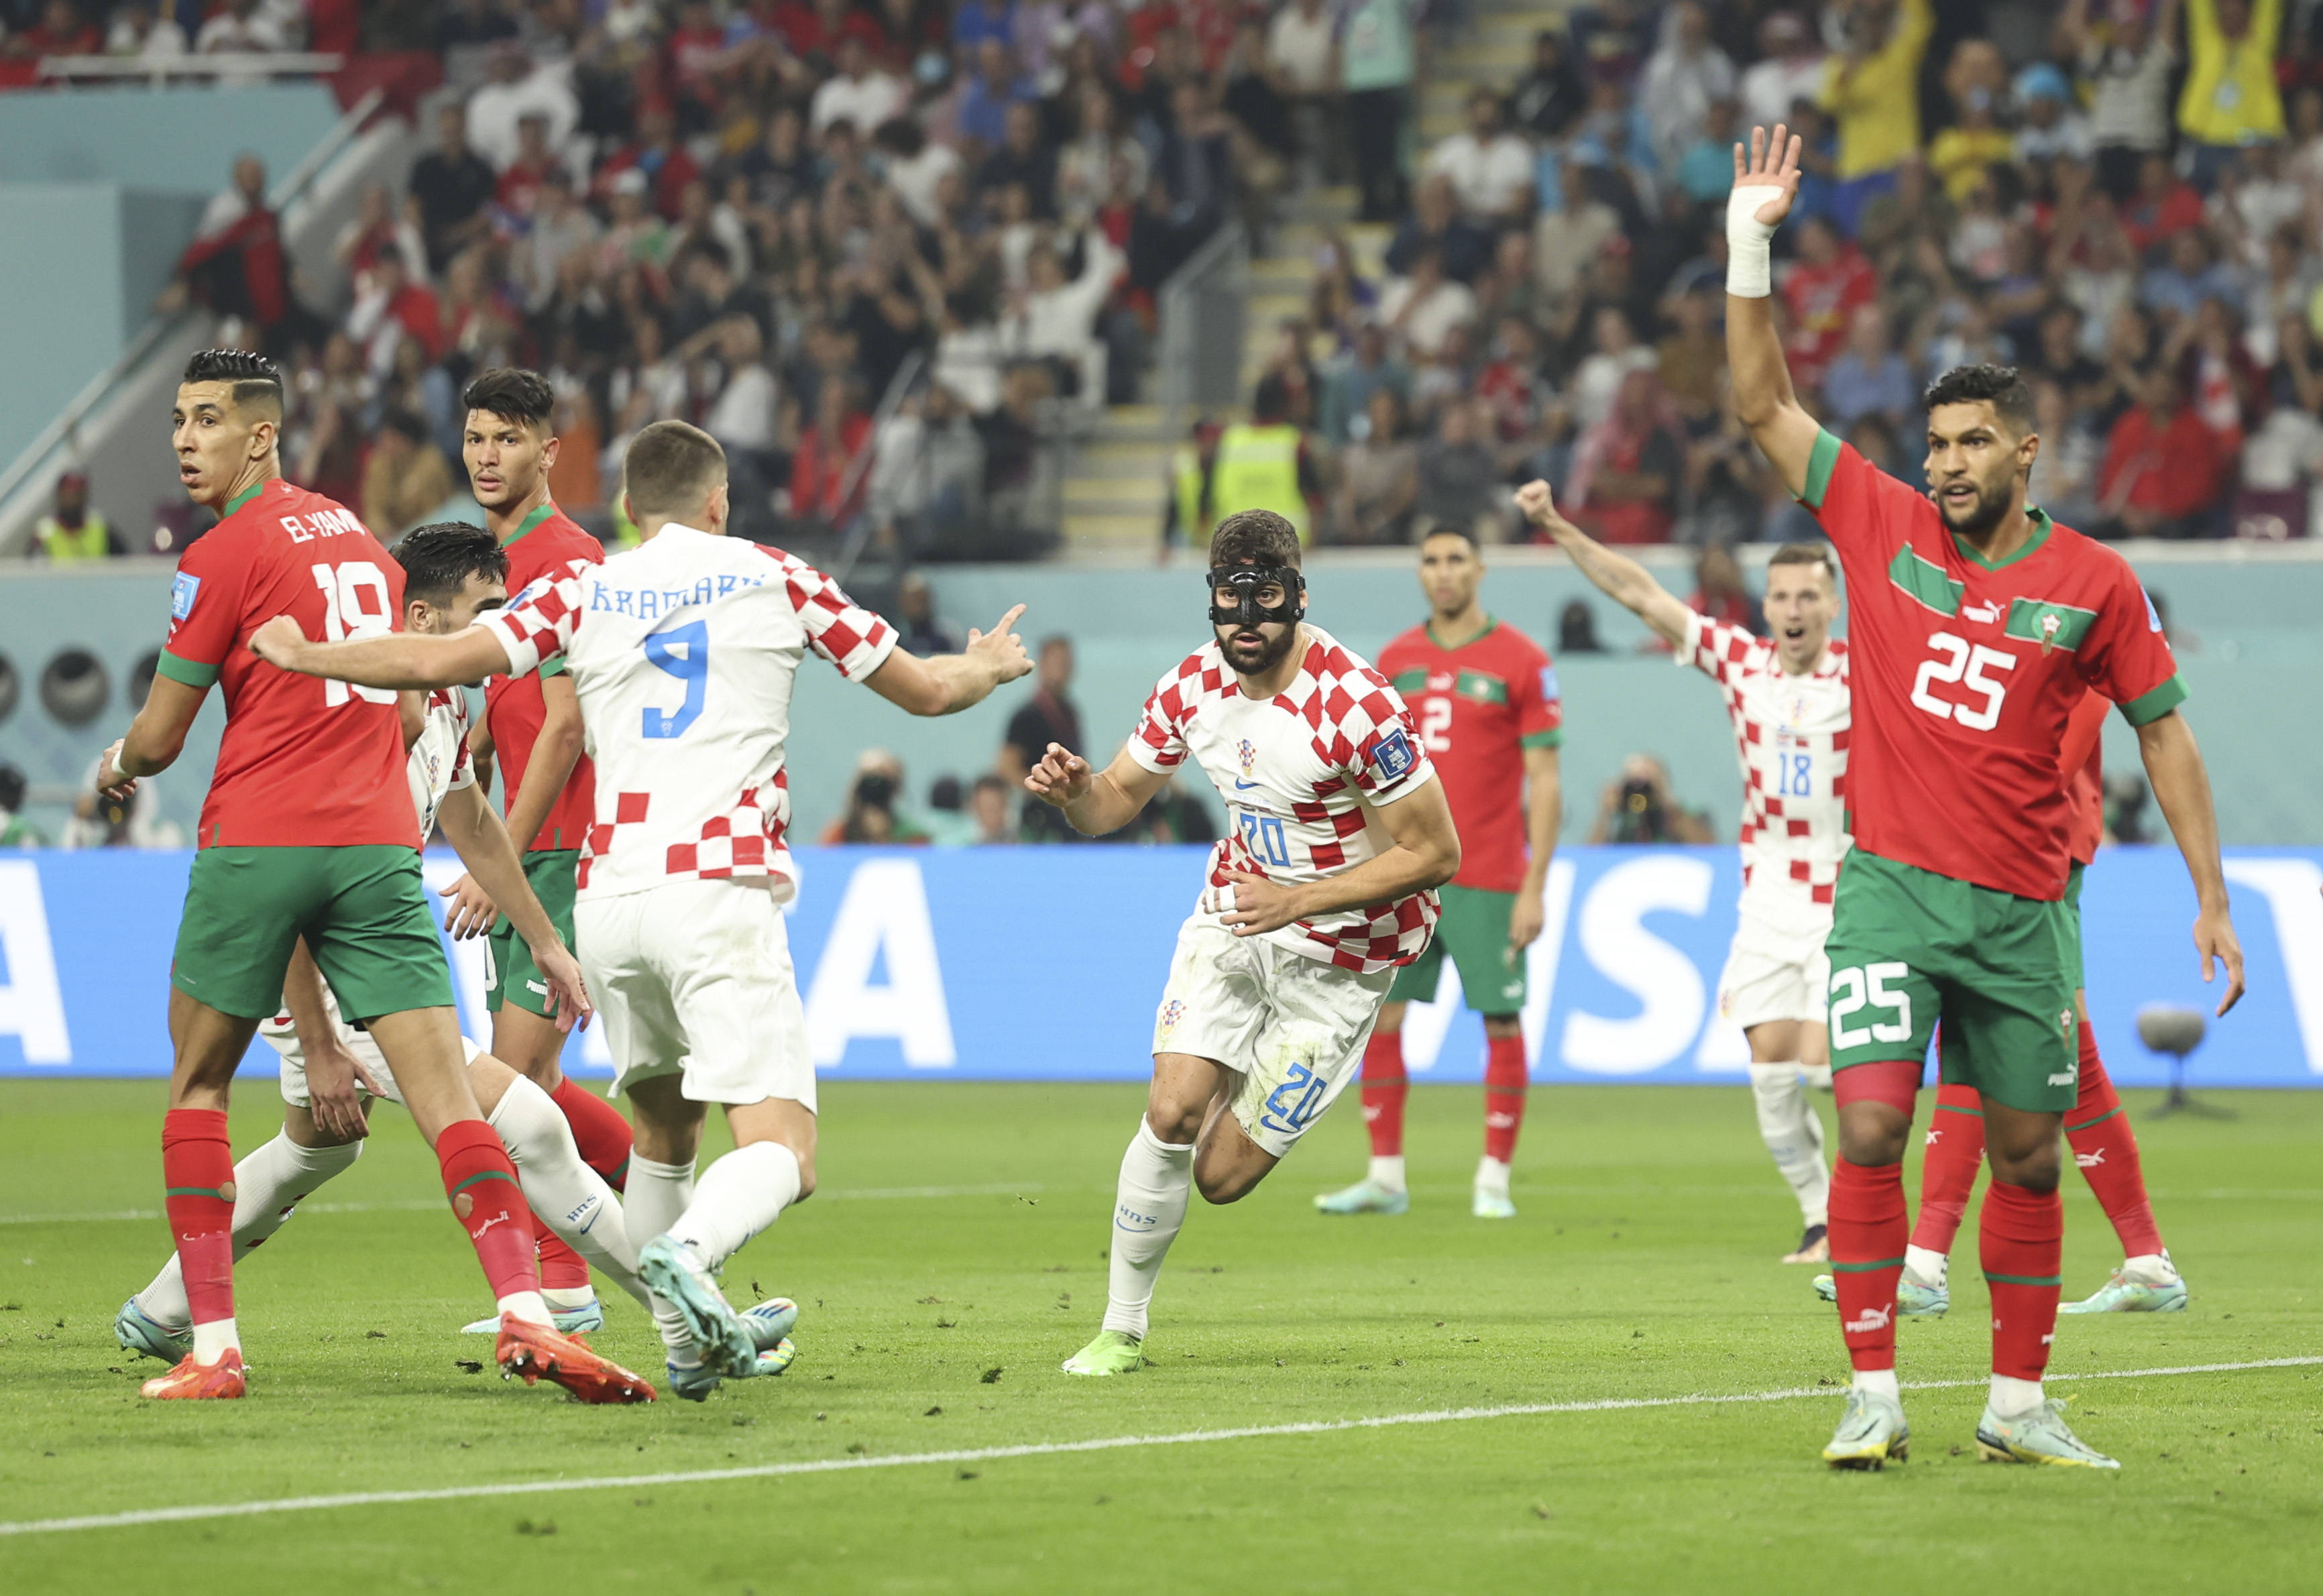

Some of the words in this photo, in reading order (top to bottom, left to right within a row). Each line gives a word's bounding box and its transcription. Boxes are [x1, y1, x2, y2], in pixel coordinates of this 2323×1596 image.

[280, 508, 365, 544] EL-YAM
[591, 574, 766, 620] KRAMAR
[311, 561, 398, 707] 18
[642, 620, 709, 738] 9
[1910, 631, 2017, 732] 25
[1421, 696, 1453, 752] 2
[1779, 752, 1811, 797] 18
[1240, 813, 1292, 867] 20
[526, 978, 549, 996] PUM
[1830, 962, 1913, 1051] 25
[1265, 1062, 1328, 1130] 20
